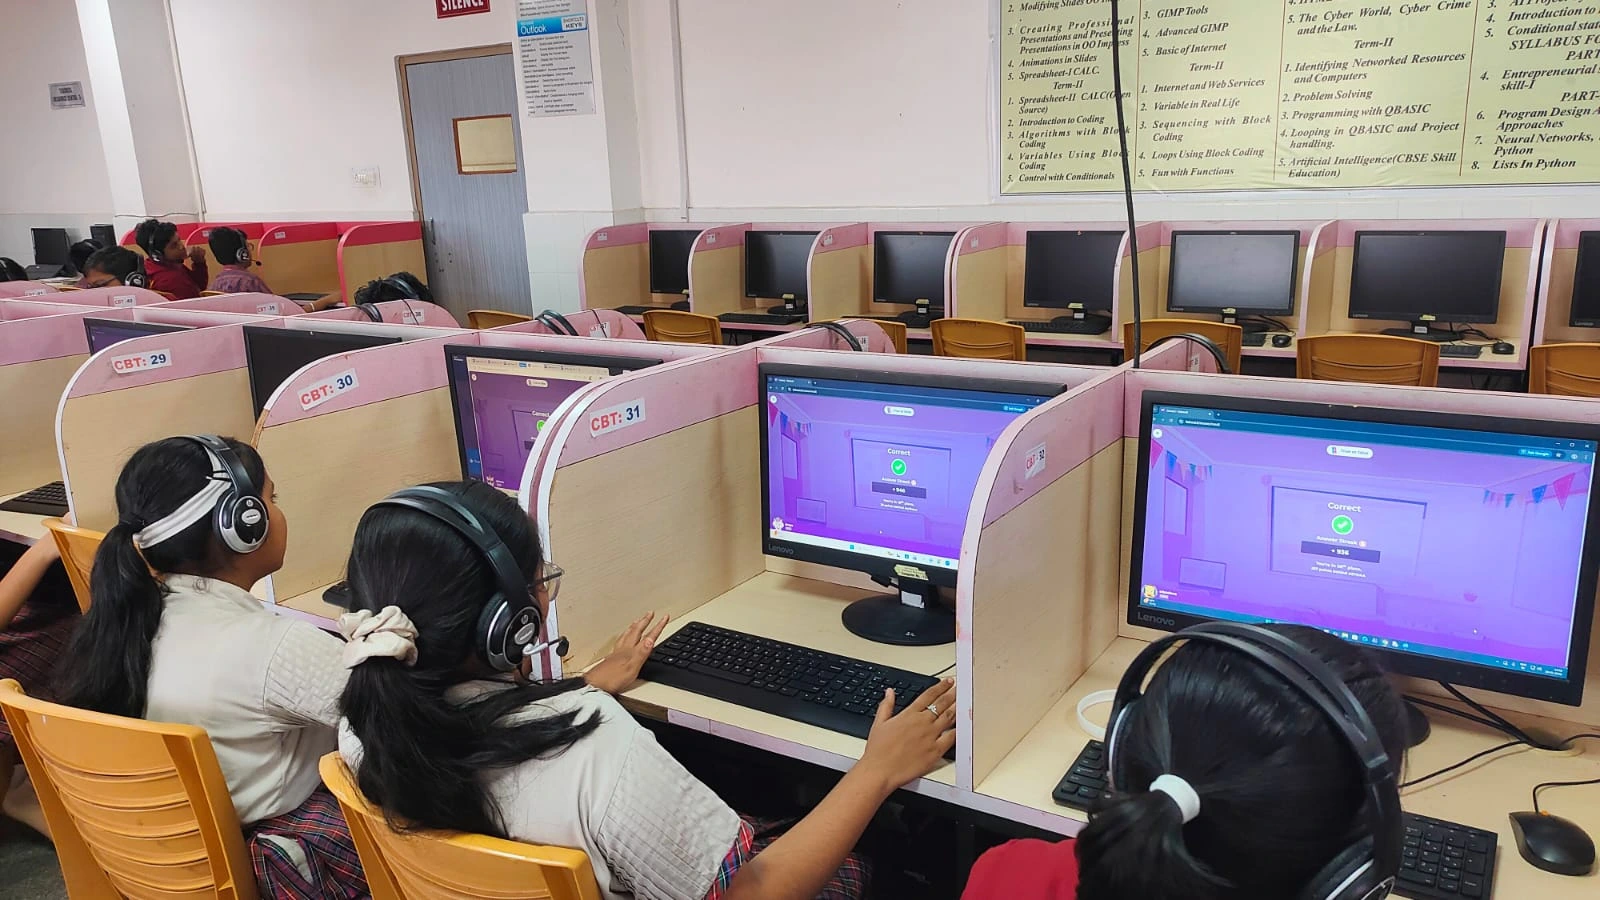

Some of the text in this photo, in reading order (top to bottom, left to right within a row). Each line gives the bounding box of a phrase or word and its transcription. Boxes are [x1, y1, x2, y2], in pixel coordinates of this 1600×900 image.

[1020, 0, 1059, 12] Modifying
[1157, 8, 1184, 18] GIMP
[1186, 5, 1209, 16] Tools
[1300, 13, 1318, 23] The
[1324, 10, 1353, 22] Cyber
[1360, 6, 1392, 17] World,
[1400, 4, 1431, 16] Cyber
[1437, 0, 1472, 10] Crime
[1486, 6, 1596, 23] 4. Introduction to
[520, 24, 546, 35] Outlook
[1020, 24, 1062, 34] Creating
[1156, 25, 1199, 37] Advanced
[1200, 22, 1229, 34] GIMP
[1297, 25, 1316, 35] and
[1317, 23, 1333, 33] the
[1485, 28, 1494, 38] 5.
[1507, 21, 1577, 36] Conditional
[1020, 30, 1088, 44] Presentations and
[1354, 37, 1394, 49] Term-II
[1509, 36, 1581, 50] SYLLABUS
[1020, 40, 1096, 54] Presentations in OO
[1155, 46, 1180, 56] Basic
[1180, 45, 1190, 56] of
[1190, 43, 1227, 53] Internet
[1019, 57, 1063, 68] Animations
[1074, 54, 1098, 63] Slides
[1190, 61, 1224, 72] Term-II
[1294, 52, 1466, 73] Identifying Networked Resources
[1019, 68, 1072, 81] Spreadsheet-I
[1294, 72, 1368, 84] and Computers
[1480, 64, 1598, 81] 4. Entrepreneurial
[1053, 80, 1084, 90] Term-II
[1154, 76, 1266, 93] Internet and Web Services
[1500, 80, 1536, 91] skill-I
[1019, 94, 1076, 106] Spreadsheet-II
[1293, 92, 1334, 102] Problem
[1335, 89, 1373, 100] Solving
[1154, 100, 1190, 110] Variable
[1190, 100, 1199, 109] in
[1200, 98, 1220, 108] Real
[1222, 97, 1240, 108] Life
[1019, 106, 1048, 115] Source)
[1292, 109, 1359, 121] Programming
[1361, 107, 1382, 117] with
[1384, 104, 1431, 117] QBASIC
[1476, 110, 1485, 120] 6.
[1498, 109, 1548, 121] Program
[1549, 106, 1591, 118] Design
[1019, 116, 1067, 127] Introduction
[1076, 115, 1105, 124] Coding
[1152, 118, 1209, 130] Sequencing
[1215, 116, 1236, 126] with
[1242, 114, 1272, 125] Block
[1496, 119, 1564, 133] Approaches
[1019, 126, 1130, 140] Algorithms with Blok
[1152, 132, 1184, 142] Coding
[1291, 128, 1330, 139] Looping
[1334, 126, 1344, 136] in
[1349, 124, 1394, 136] QBASIC
[1397, 123, 1417, 133] and
[1421, 122, 1460, 133] Project
[1019, 140, 1046, 149] Coding
[1290, 139, 1335, 150] handling.
[1474, 132, 1594, 145] 7. Neural Networks,
[1020, 150, 1096, 160] Variables Using
[1152, 150, 1179, 161] Loops
[1179, 149, 1204, 159] Using
[1205, 148, 1231, 158] Block
[1232, 147, 1264, 158] Coding
[1494, 145, 1534, 157] Python
[1019, 161, 1046, 171] Coding
[1288, 156, 1332, 168] Artificial
[1431, 152, 1457, 162] Skill
[1471, 158, 1576, 171] 8. Lists In Python
[1019, 171, 1115, 182] Control with Conditionals
[1152, 168, 1169, 177] Fun
[1171, 168, 1188, 176] with
[1190, 167, 1234, 176] Functions
[1288, 168, 1340, 178] Education)
[114, 354, 166, 370] CBT: 29
[301, 374, 353, 405] CBT: 30
[591, 405, 640, 431] CBT: 31
[1328, 502, 1361, 512] Correct
[1137, 612, 1175, 626] Lenovo
